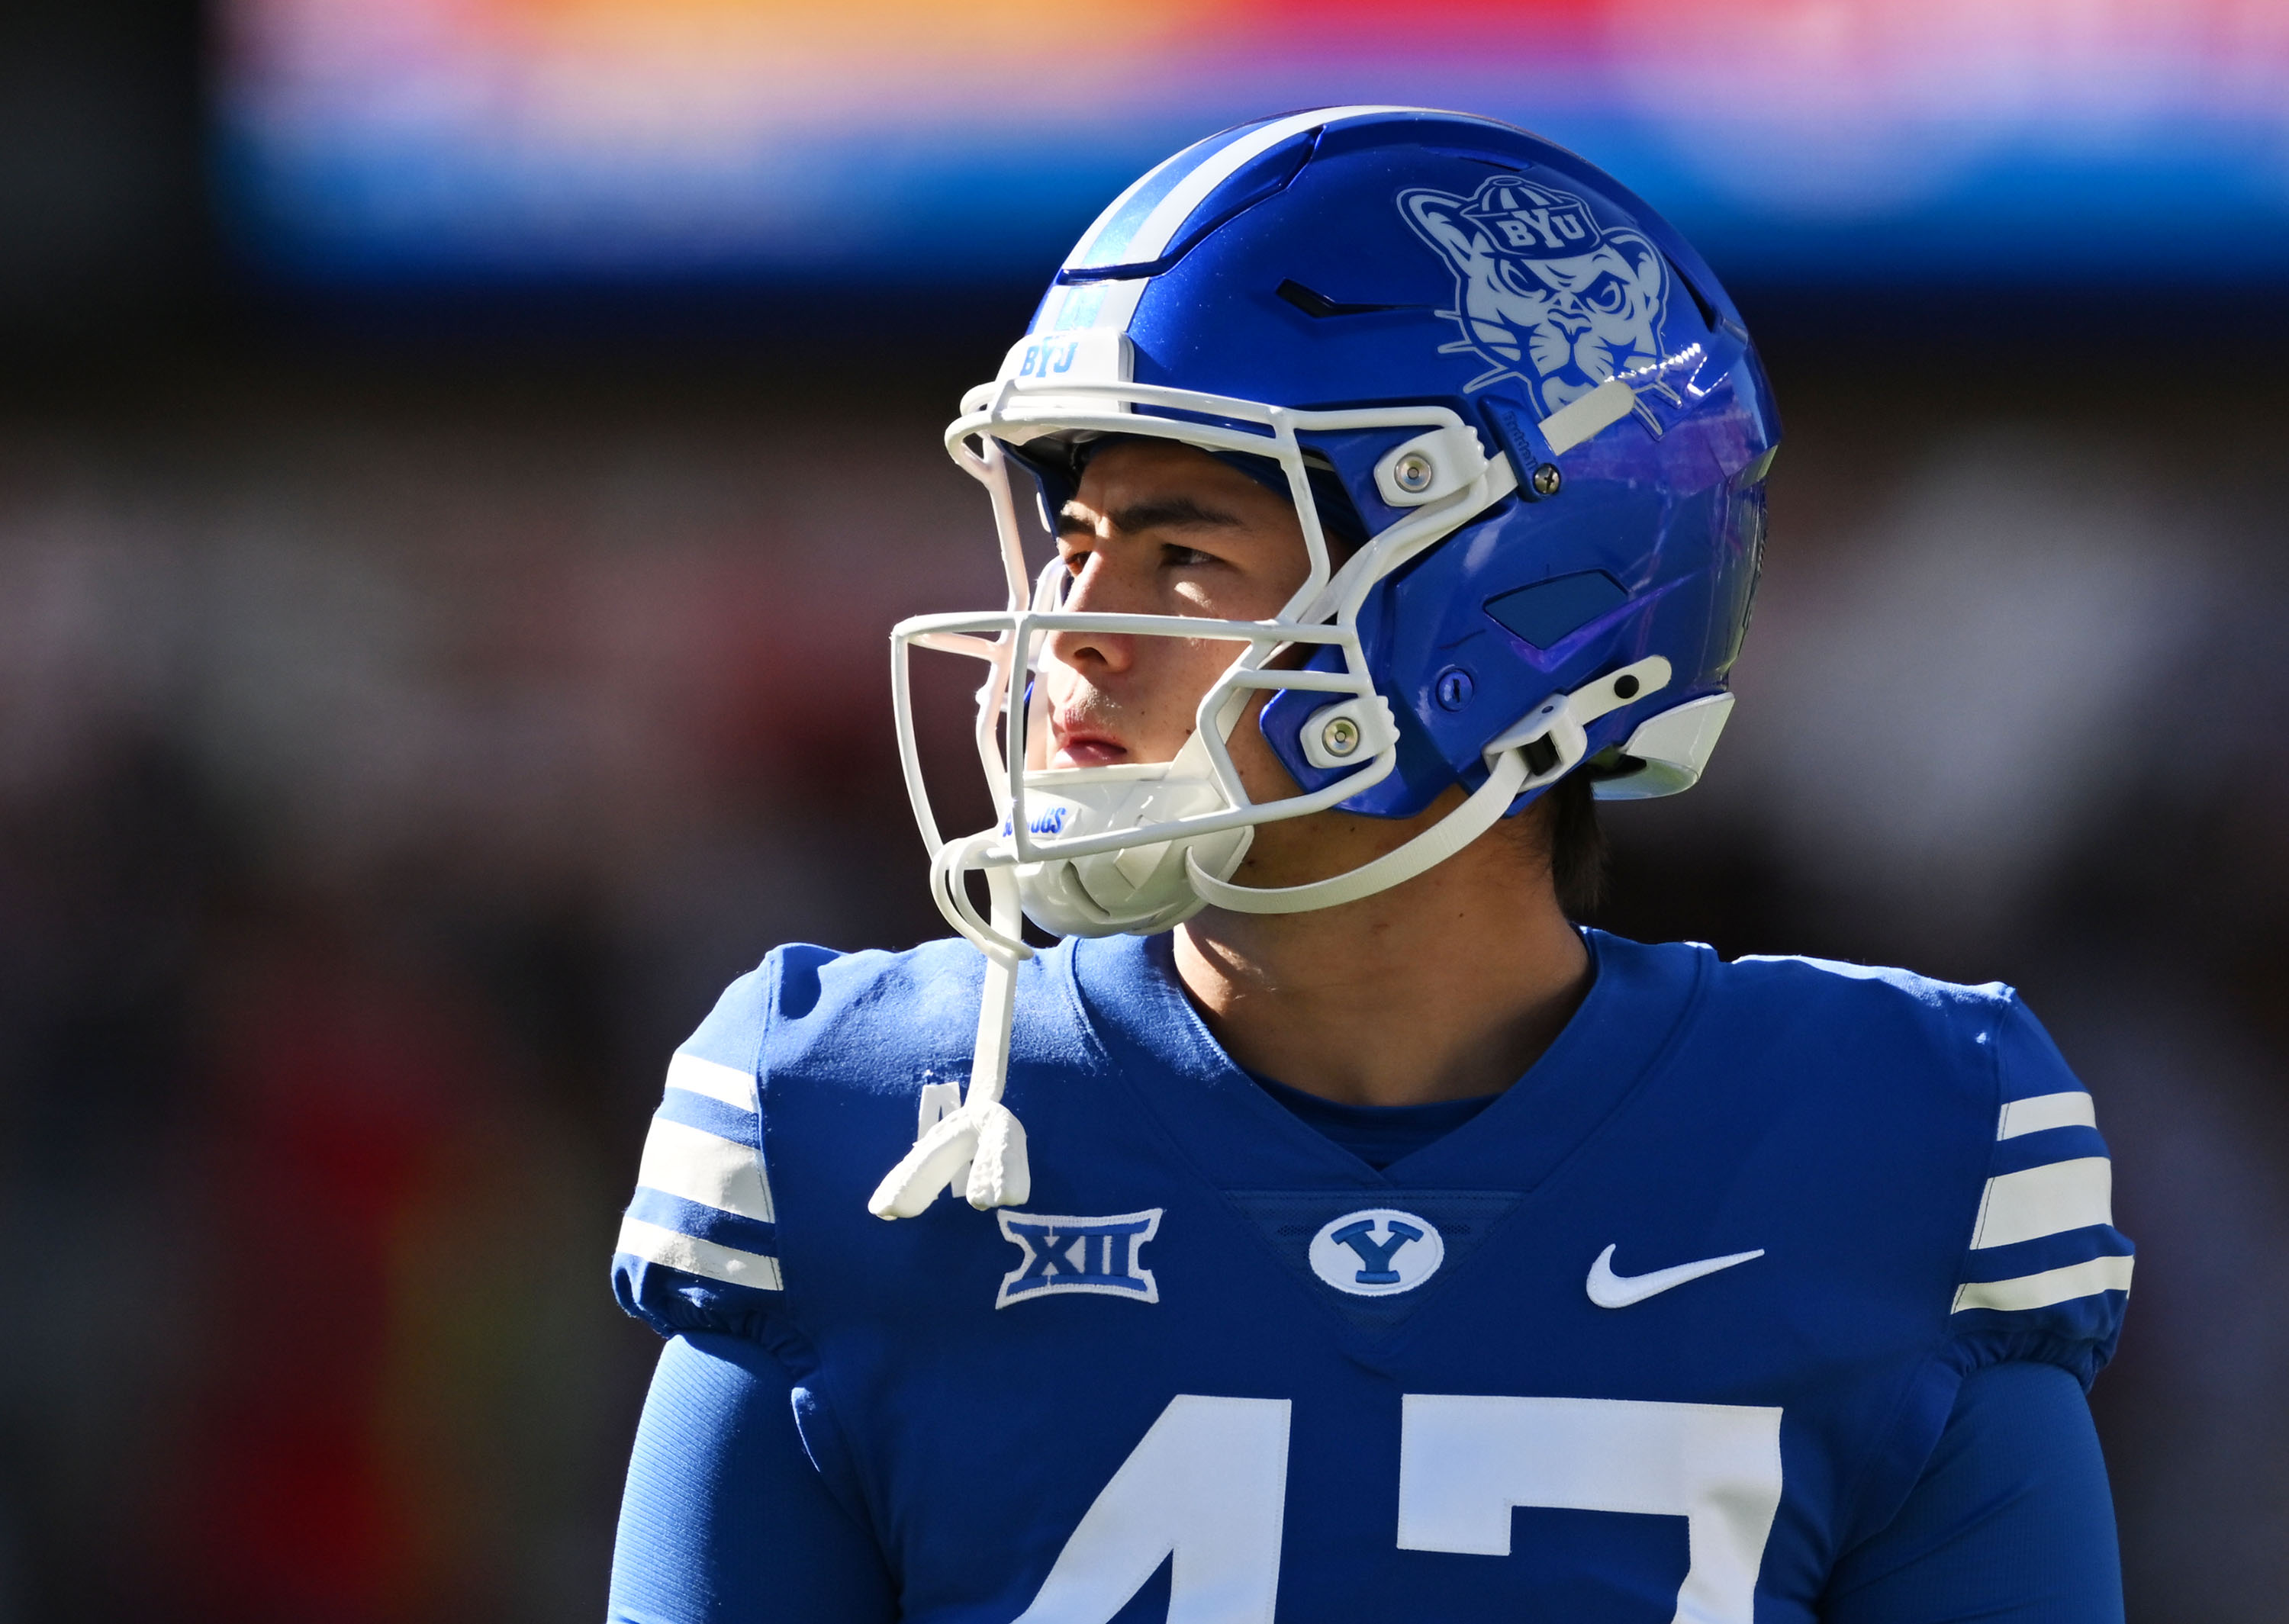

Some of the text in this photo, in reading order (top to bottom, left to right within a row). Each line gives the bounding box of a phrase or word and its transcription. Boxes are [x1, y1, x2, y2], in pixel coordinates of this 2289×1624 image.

[1497, 207, 1586, 249] BYU
[1006, 1218, 1151, 1296] XII
[1331, 1219, 1425, 1285] Y
